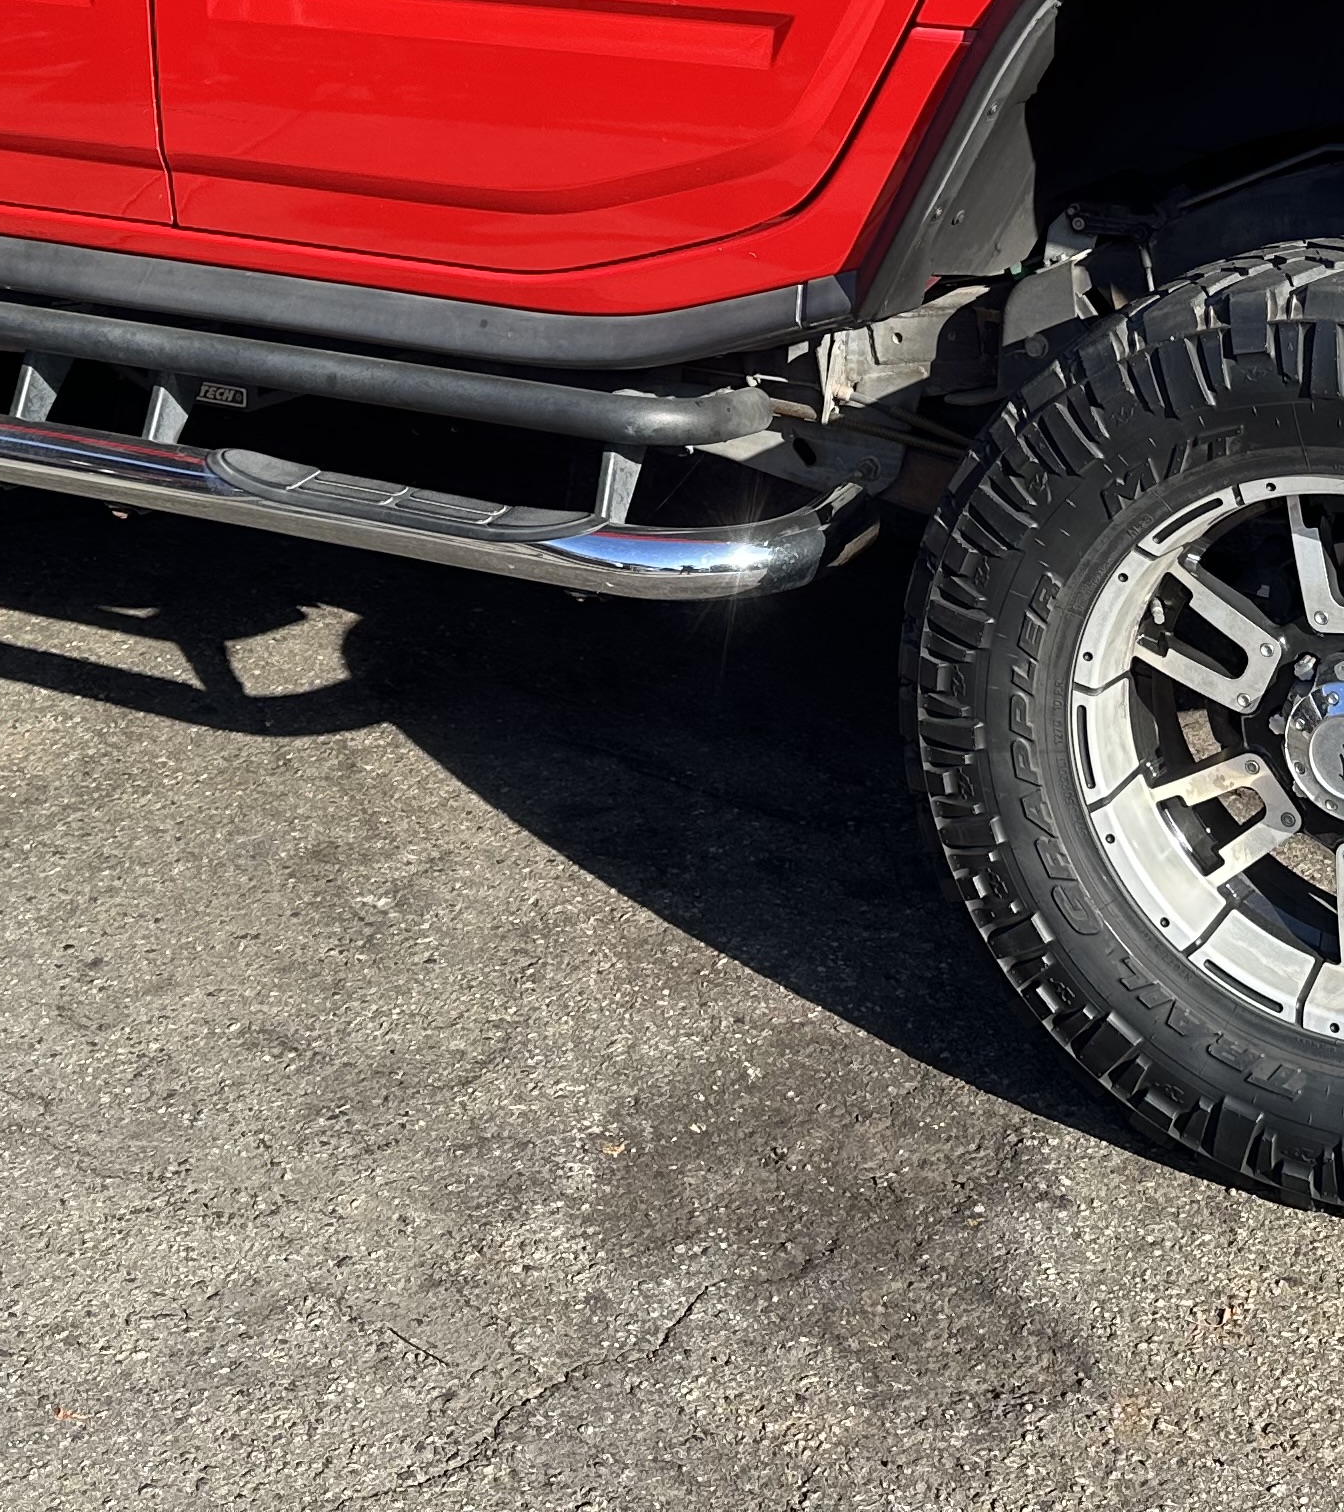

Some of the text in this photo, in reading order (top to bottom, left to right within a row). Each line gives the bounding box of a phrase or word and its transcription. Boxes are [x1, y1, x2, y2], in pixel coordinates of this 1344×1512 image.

[1100, 423, 1246, 520] M/T
[1008, 571, 1103, 937] GRAPPLER
[1117, 955, 1308, 1101] TRAIL
